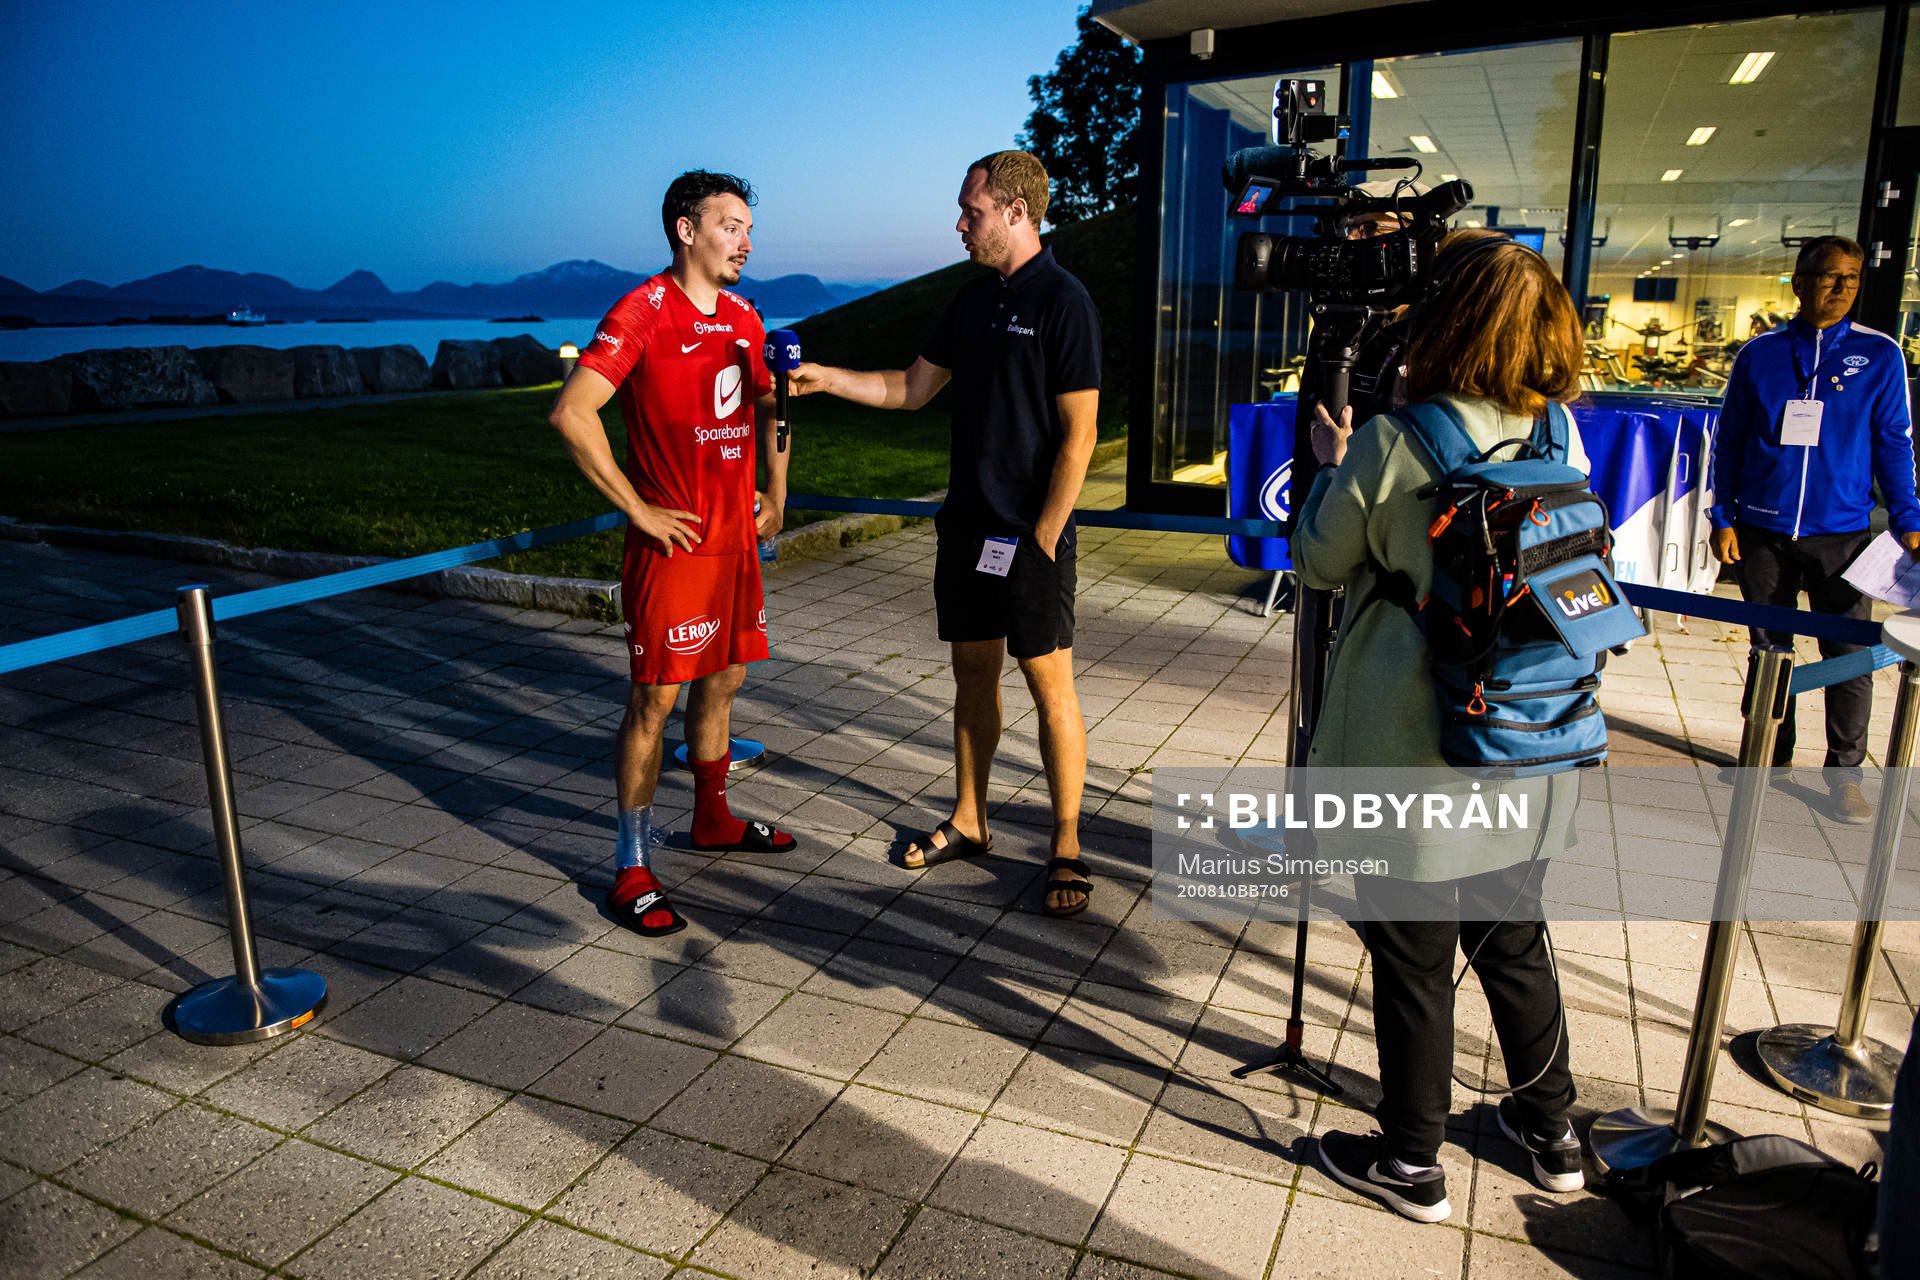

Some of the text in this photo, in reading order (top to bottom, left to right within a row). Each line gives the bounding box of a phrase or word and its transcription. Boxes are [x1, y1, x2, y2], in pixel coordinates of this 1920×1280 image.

[730, 295, 750, 312] BOB
[720, 445, 742, 460] Vest
[668, 619, 717, 643] LERØY
[636, 892, 657, 908] NIKE
